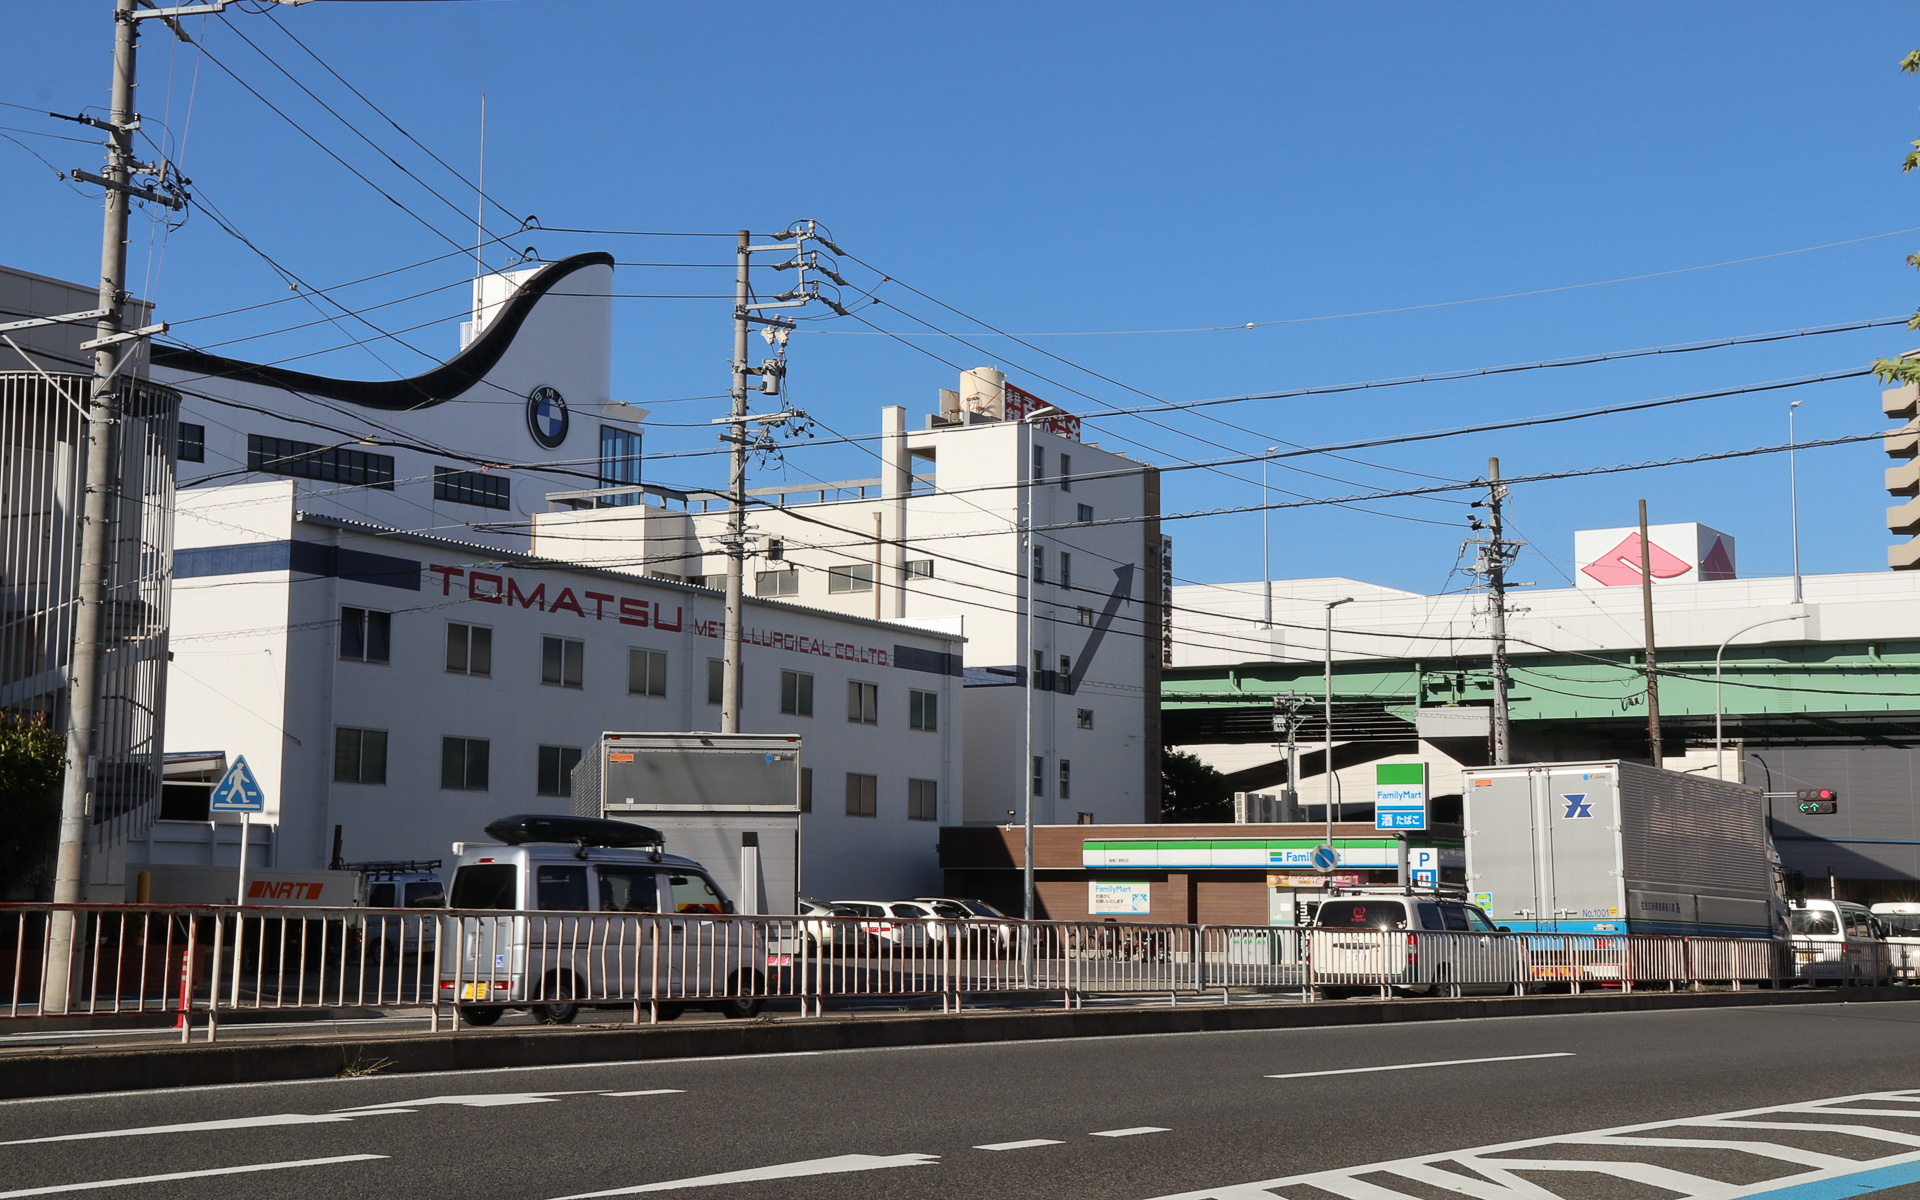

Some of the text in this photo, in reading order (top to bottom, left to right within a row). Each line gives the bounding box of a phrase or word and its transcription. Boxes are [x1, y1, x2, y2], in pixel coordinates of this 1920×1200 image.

[429, 564, 682, 633] TOMATSU
[694, 618, 831, 657] METLLURGICAL
[1378, 791, 1422, 801] FamilyMart
[1381, 814, 1420, 826] 酒 たばこ
[1420, 852, 1430, 867] P
[261, 881, 310, 899] NRT
[1096, 885, 1132, 894] FamilyMart
[1582, 908, 1609, 918] No.1001
